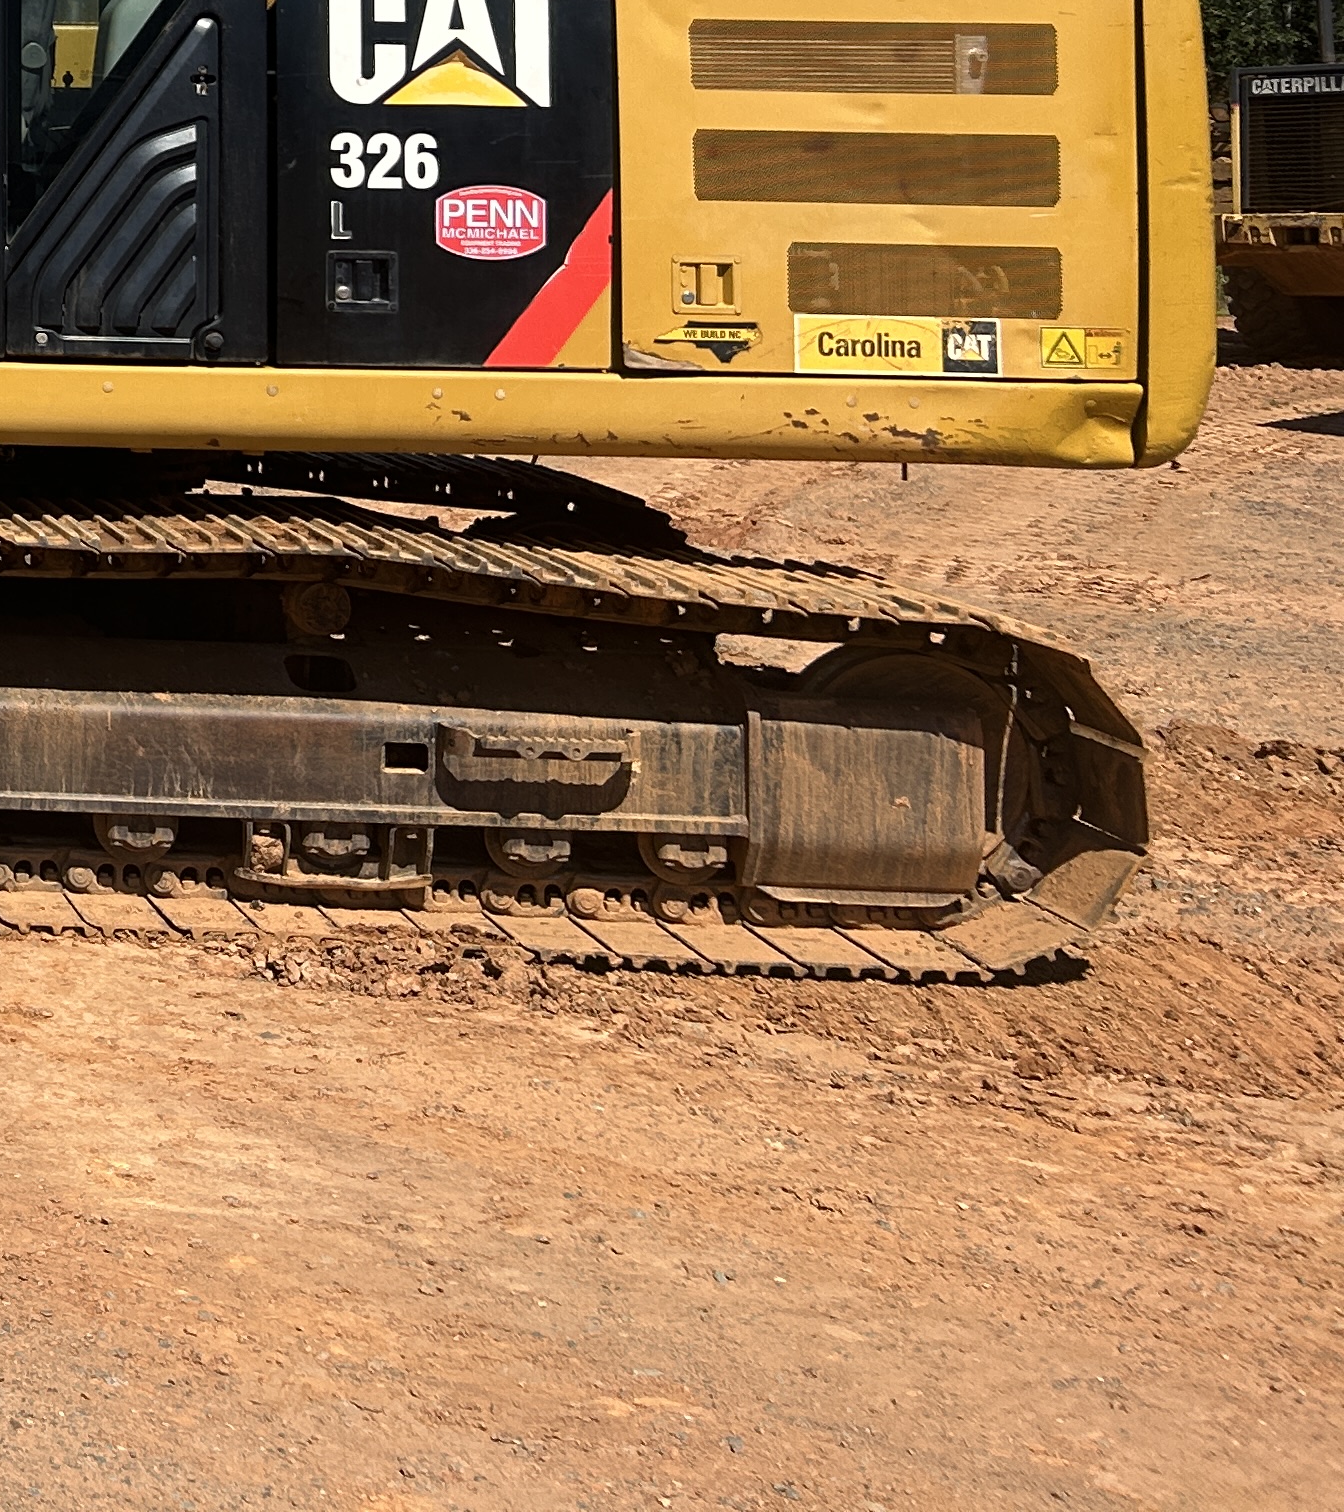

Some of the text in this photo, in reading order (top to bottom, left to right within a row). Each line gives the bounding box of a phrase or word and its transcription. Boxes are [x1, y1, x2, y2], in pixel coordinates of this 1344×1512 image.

[1251, 76, 1344, 95] CATERPILL
[329, 132, 440, 190] 326
[330, 200, 353, 240] L
[443, 198, 539, 228] PENN
[441, 227, 539, 240] MCMICHAEL
[682, 329, 742, 339] WE BUILD NC
[817, 331, 993, 362] Carolina CAT
